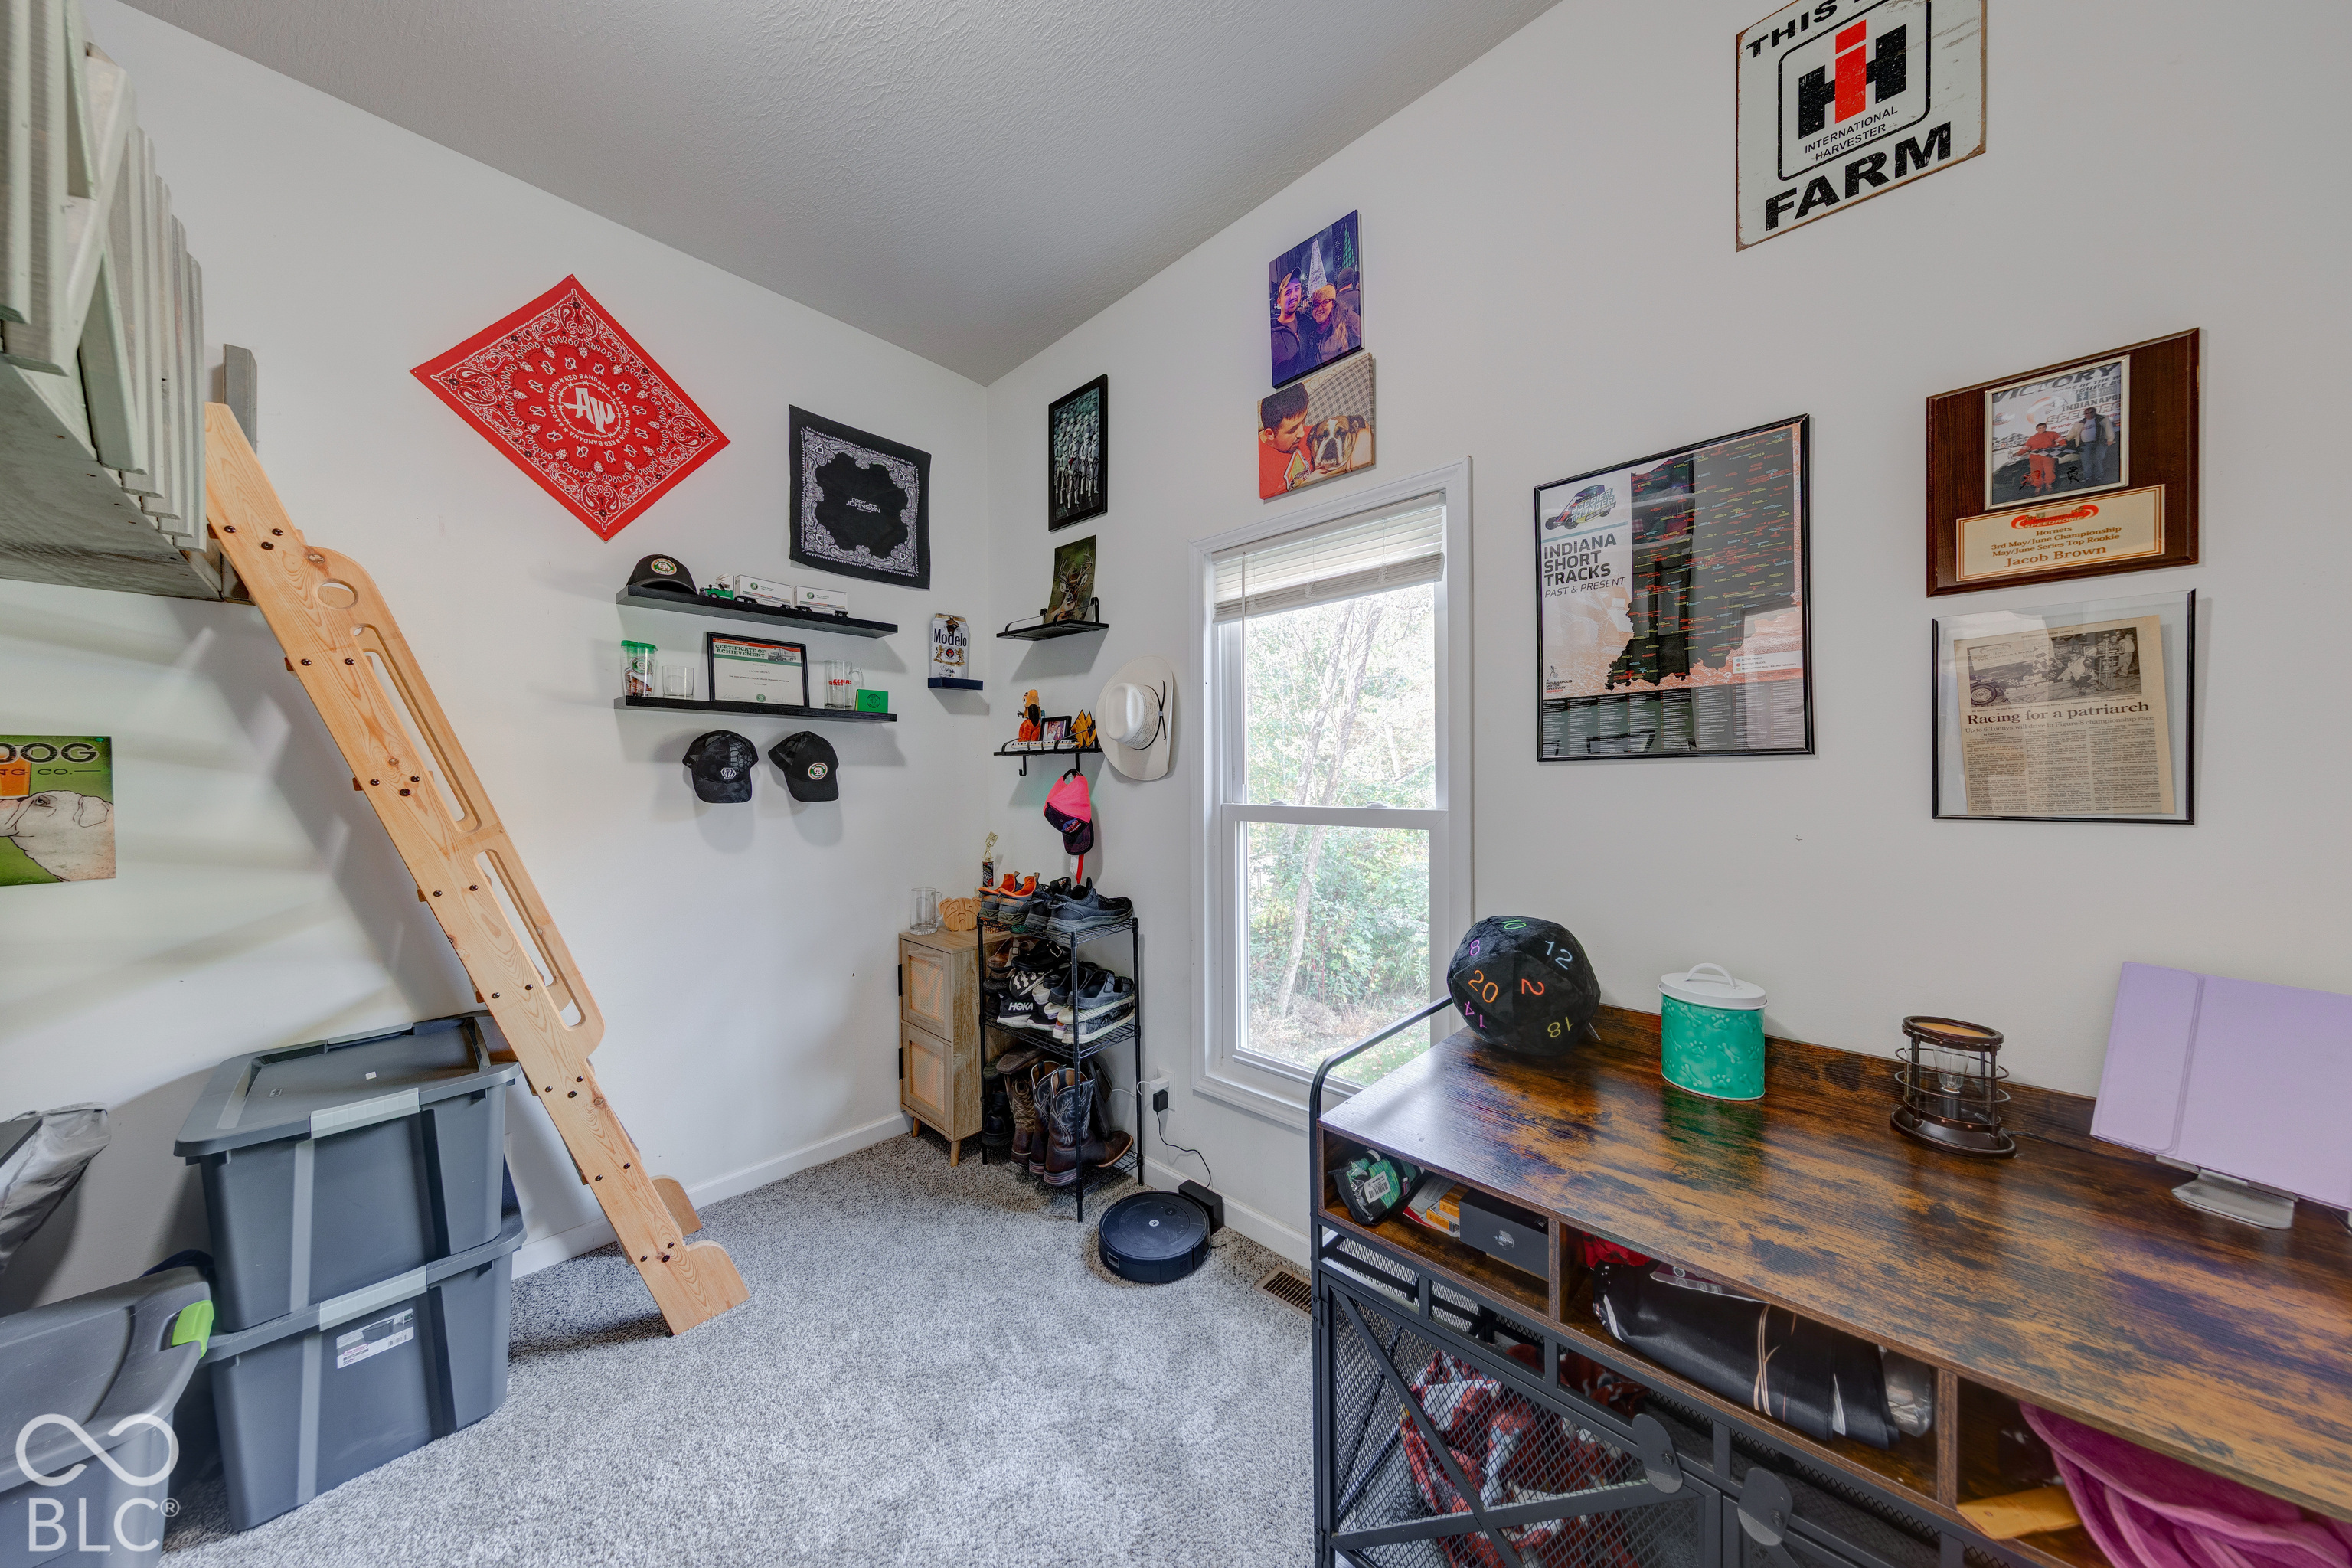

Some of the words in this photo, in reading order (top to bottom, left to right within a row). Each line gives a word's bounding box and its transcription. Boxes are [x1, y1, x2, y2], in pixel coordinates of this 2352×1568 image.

[1746, 0, 1838, 58] THIS
[1805, 106, 1898, 154] INTERNATIONAL
[1815, 123, 1886, 162] HARVESTER
[1766, 121, 1951, 231] FARM
[548, 381, 561, 402] WATSON
[564, 374, 578, 382] RED
[579, 374, 610, 391] BANDANA
[1992, 362, 2121, 403] VICTORY
[549, 404, 564, 426] AARON
[615, 397, 630, 418] AARON
[570, 431, 603, 446] BANDANA
[619, 420, 631, 440] WATSON
[846, 500, 880, 513] JOHNSON
[1571, 497, 1615, 522] THUNDER
[1572, 488, 1614, 514] HOOSIER
[2024, 515, 2085, 528] SPEEDROME
[2036, 526, 2073, 537] Hornets
[1544, 533, 1617, 559] INDIANA
[1992, 547, 2036, 557] May/June
[2037, 541, 2064, 550] Series
[2087, 534, 2120, 544] Rookie
[2009, 537, 2052, 547] May/June
[2054, 526, 2122, 541] Championship
[1544, 550, 1601, 573] SHORT
[2004, 554, 2049, 568] Jacob
[2053, 546, 2107, 560] Brown
[1544, 564, 1611, 586] TRACKS
[1545, 586, 1569, 598] PAST
[1580, 577, 1626, 592] PRESENT
[934, 628, 967, 647] Modelo
[715, 644, 756, 653] CERTIFICATE
[716, 648, 765, 658] ACHIEVEMENT
[1968, 713, 2021, 725] Racing
[2025, 710, 2048, 720] for
[2067, 701, 2150, 720] patriarch
[2086, 717, 2137, 725] championship
[1469, 939, 1481, 956] 8
[1545, 939, 1573, 970] 12
[1468, 969, 1499, 1003] 20
[1521, 978, 1545, 996] 2
[1008, 1002, 1034, 1011] HOKA
[1547, 1016, 1574, 1038] 18
